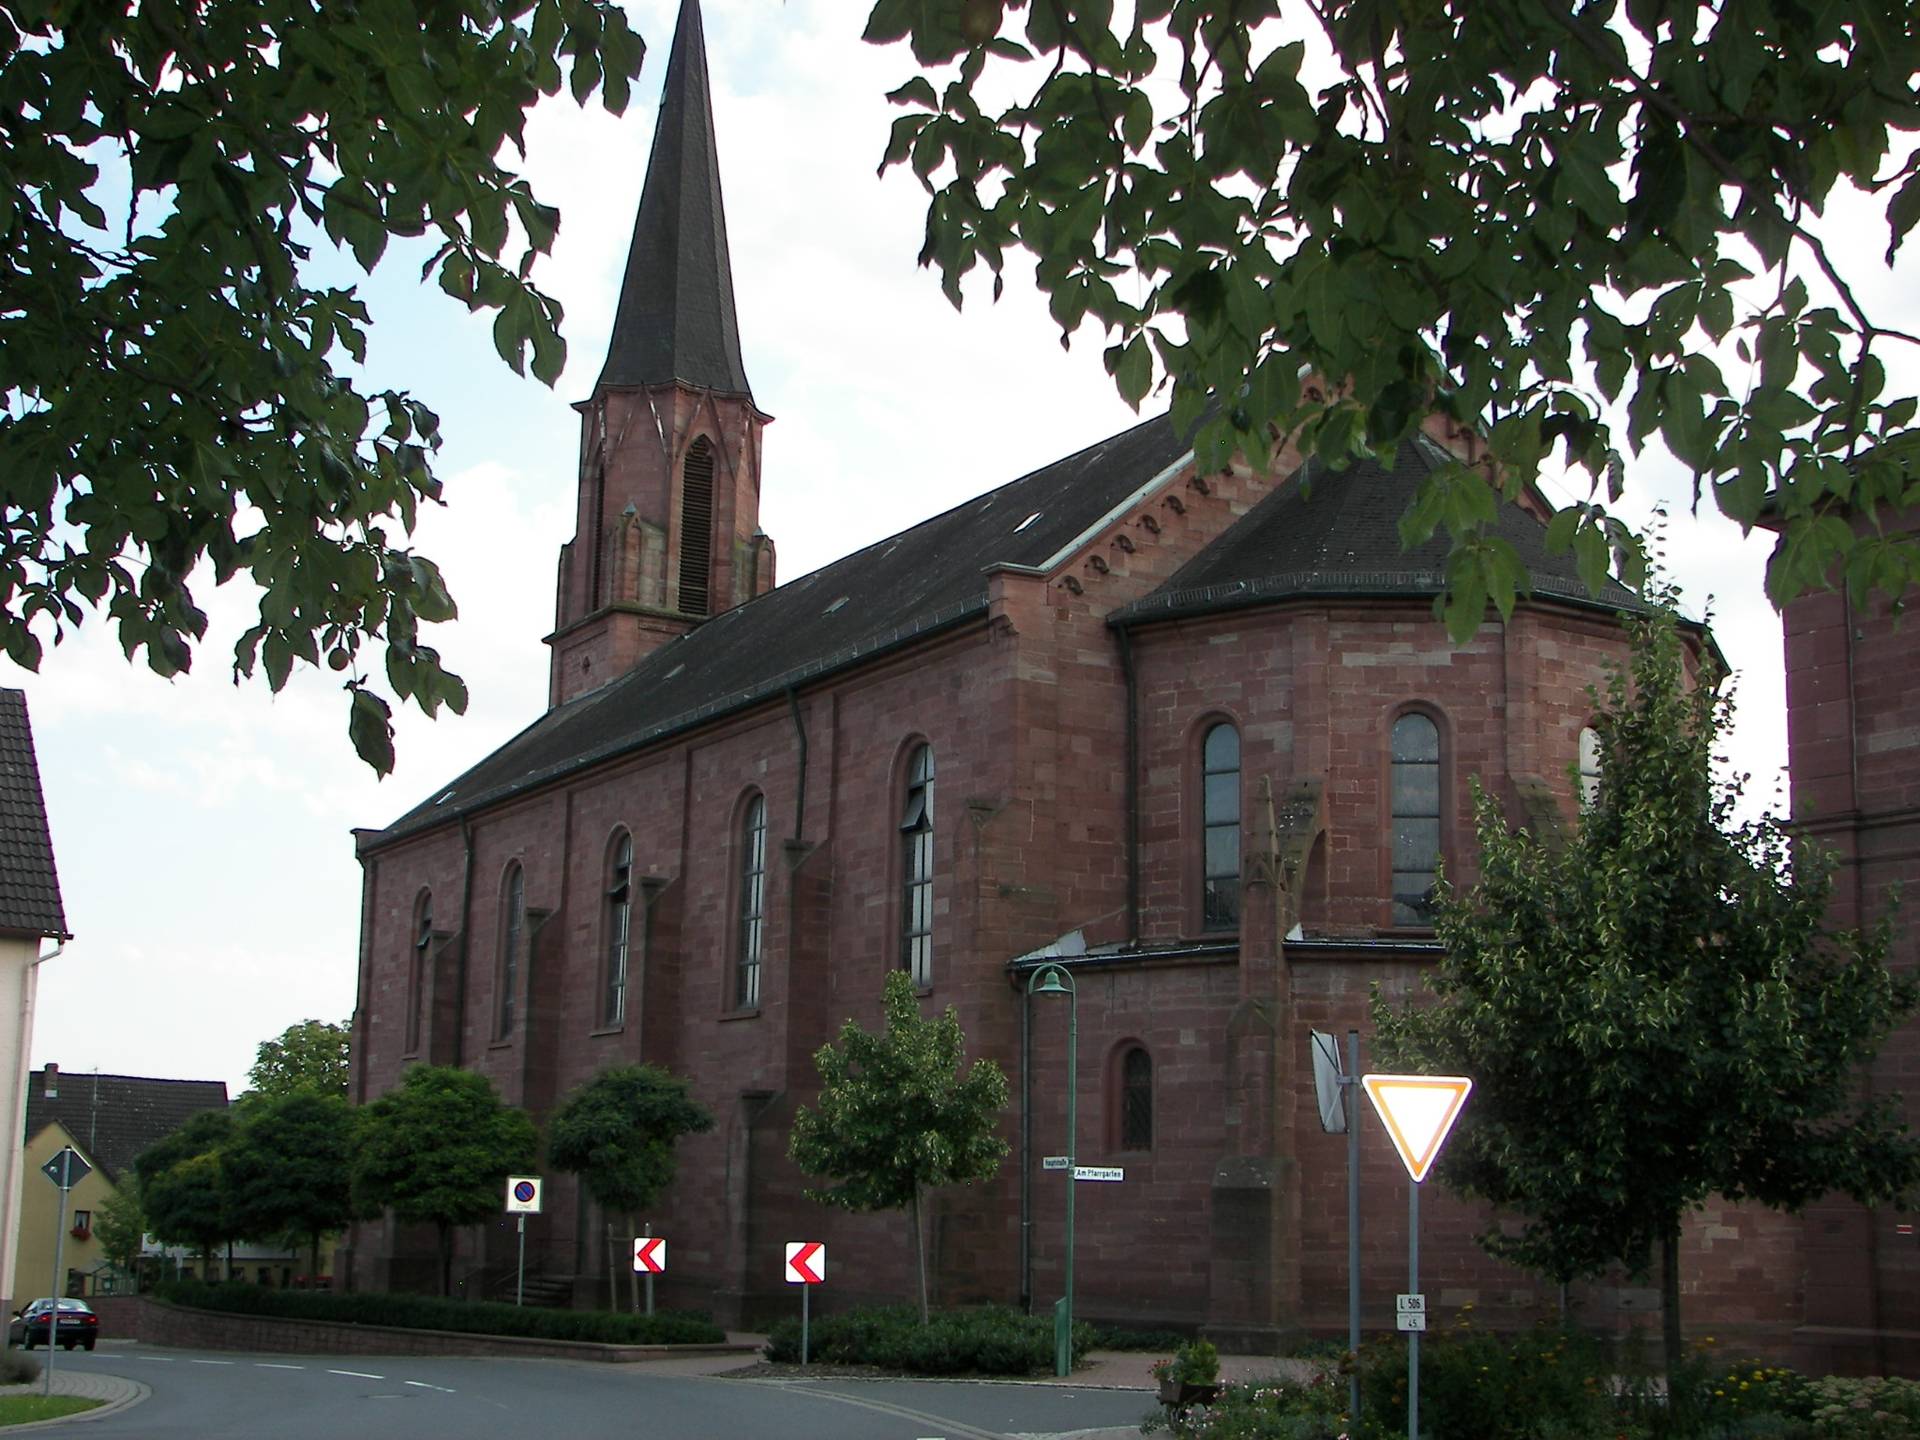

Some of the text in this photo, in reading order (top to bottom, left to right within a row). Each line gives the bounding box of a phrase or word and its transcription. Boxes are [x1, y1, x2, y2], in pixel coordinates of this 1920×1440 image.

[1077, 1169, 1121, 1179] Am Pfarrgarten
[1400, 1298, 1405, 1309] L
